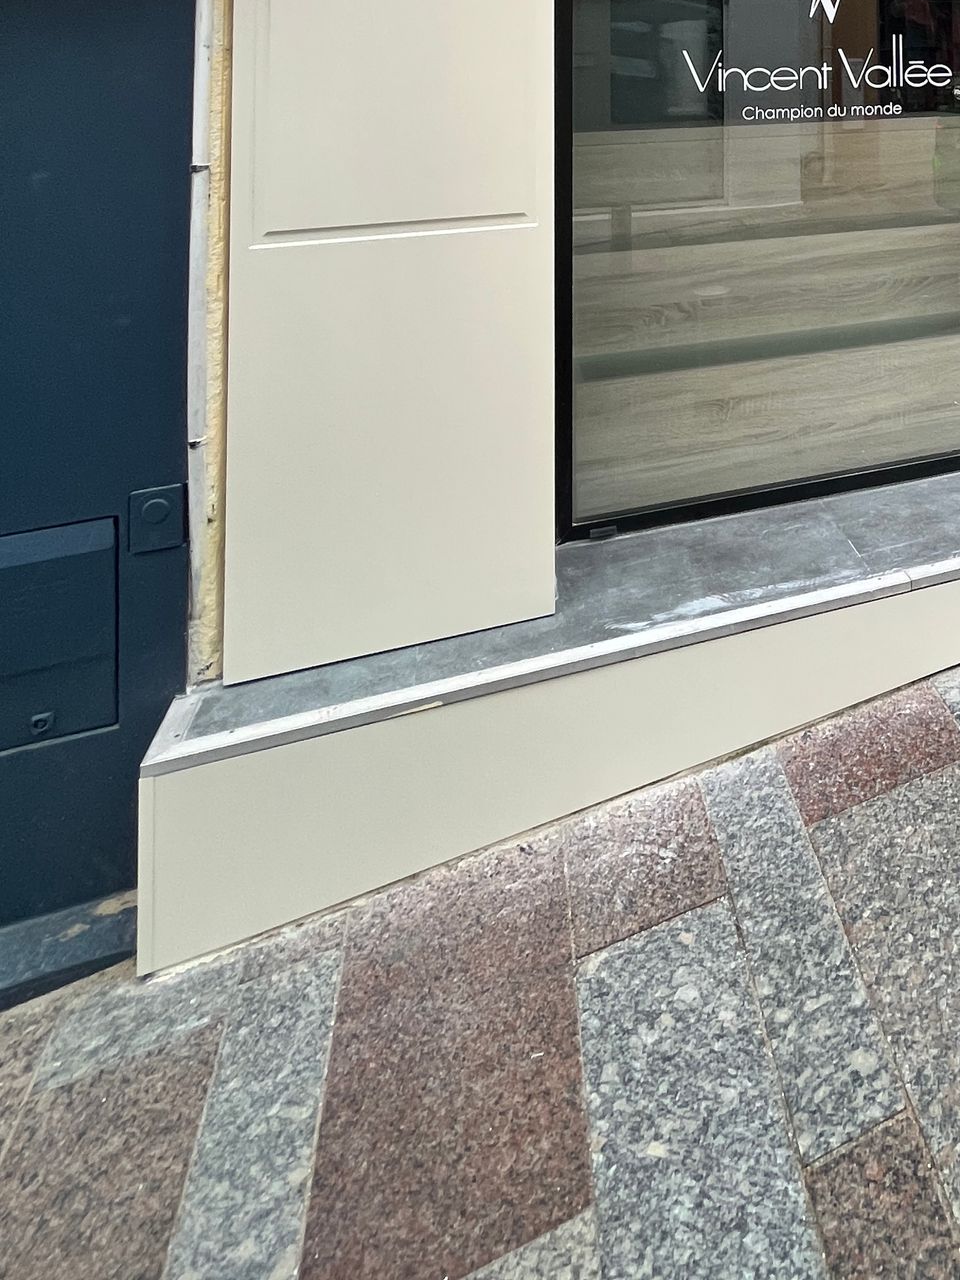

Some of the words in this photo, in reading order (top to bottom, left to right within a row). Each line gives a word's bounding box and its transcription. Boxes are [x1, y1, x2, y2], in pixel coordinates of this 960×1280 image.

[682, 48, 833, 93] Vincent
[742, 104, 823, 121] Champion
[826, 103, 847, 118] du
[850, 101, 903, 117] monde
